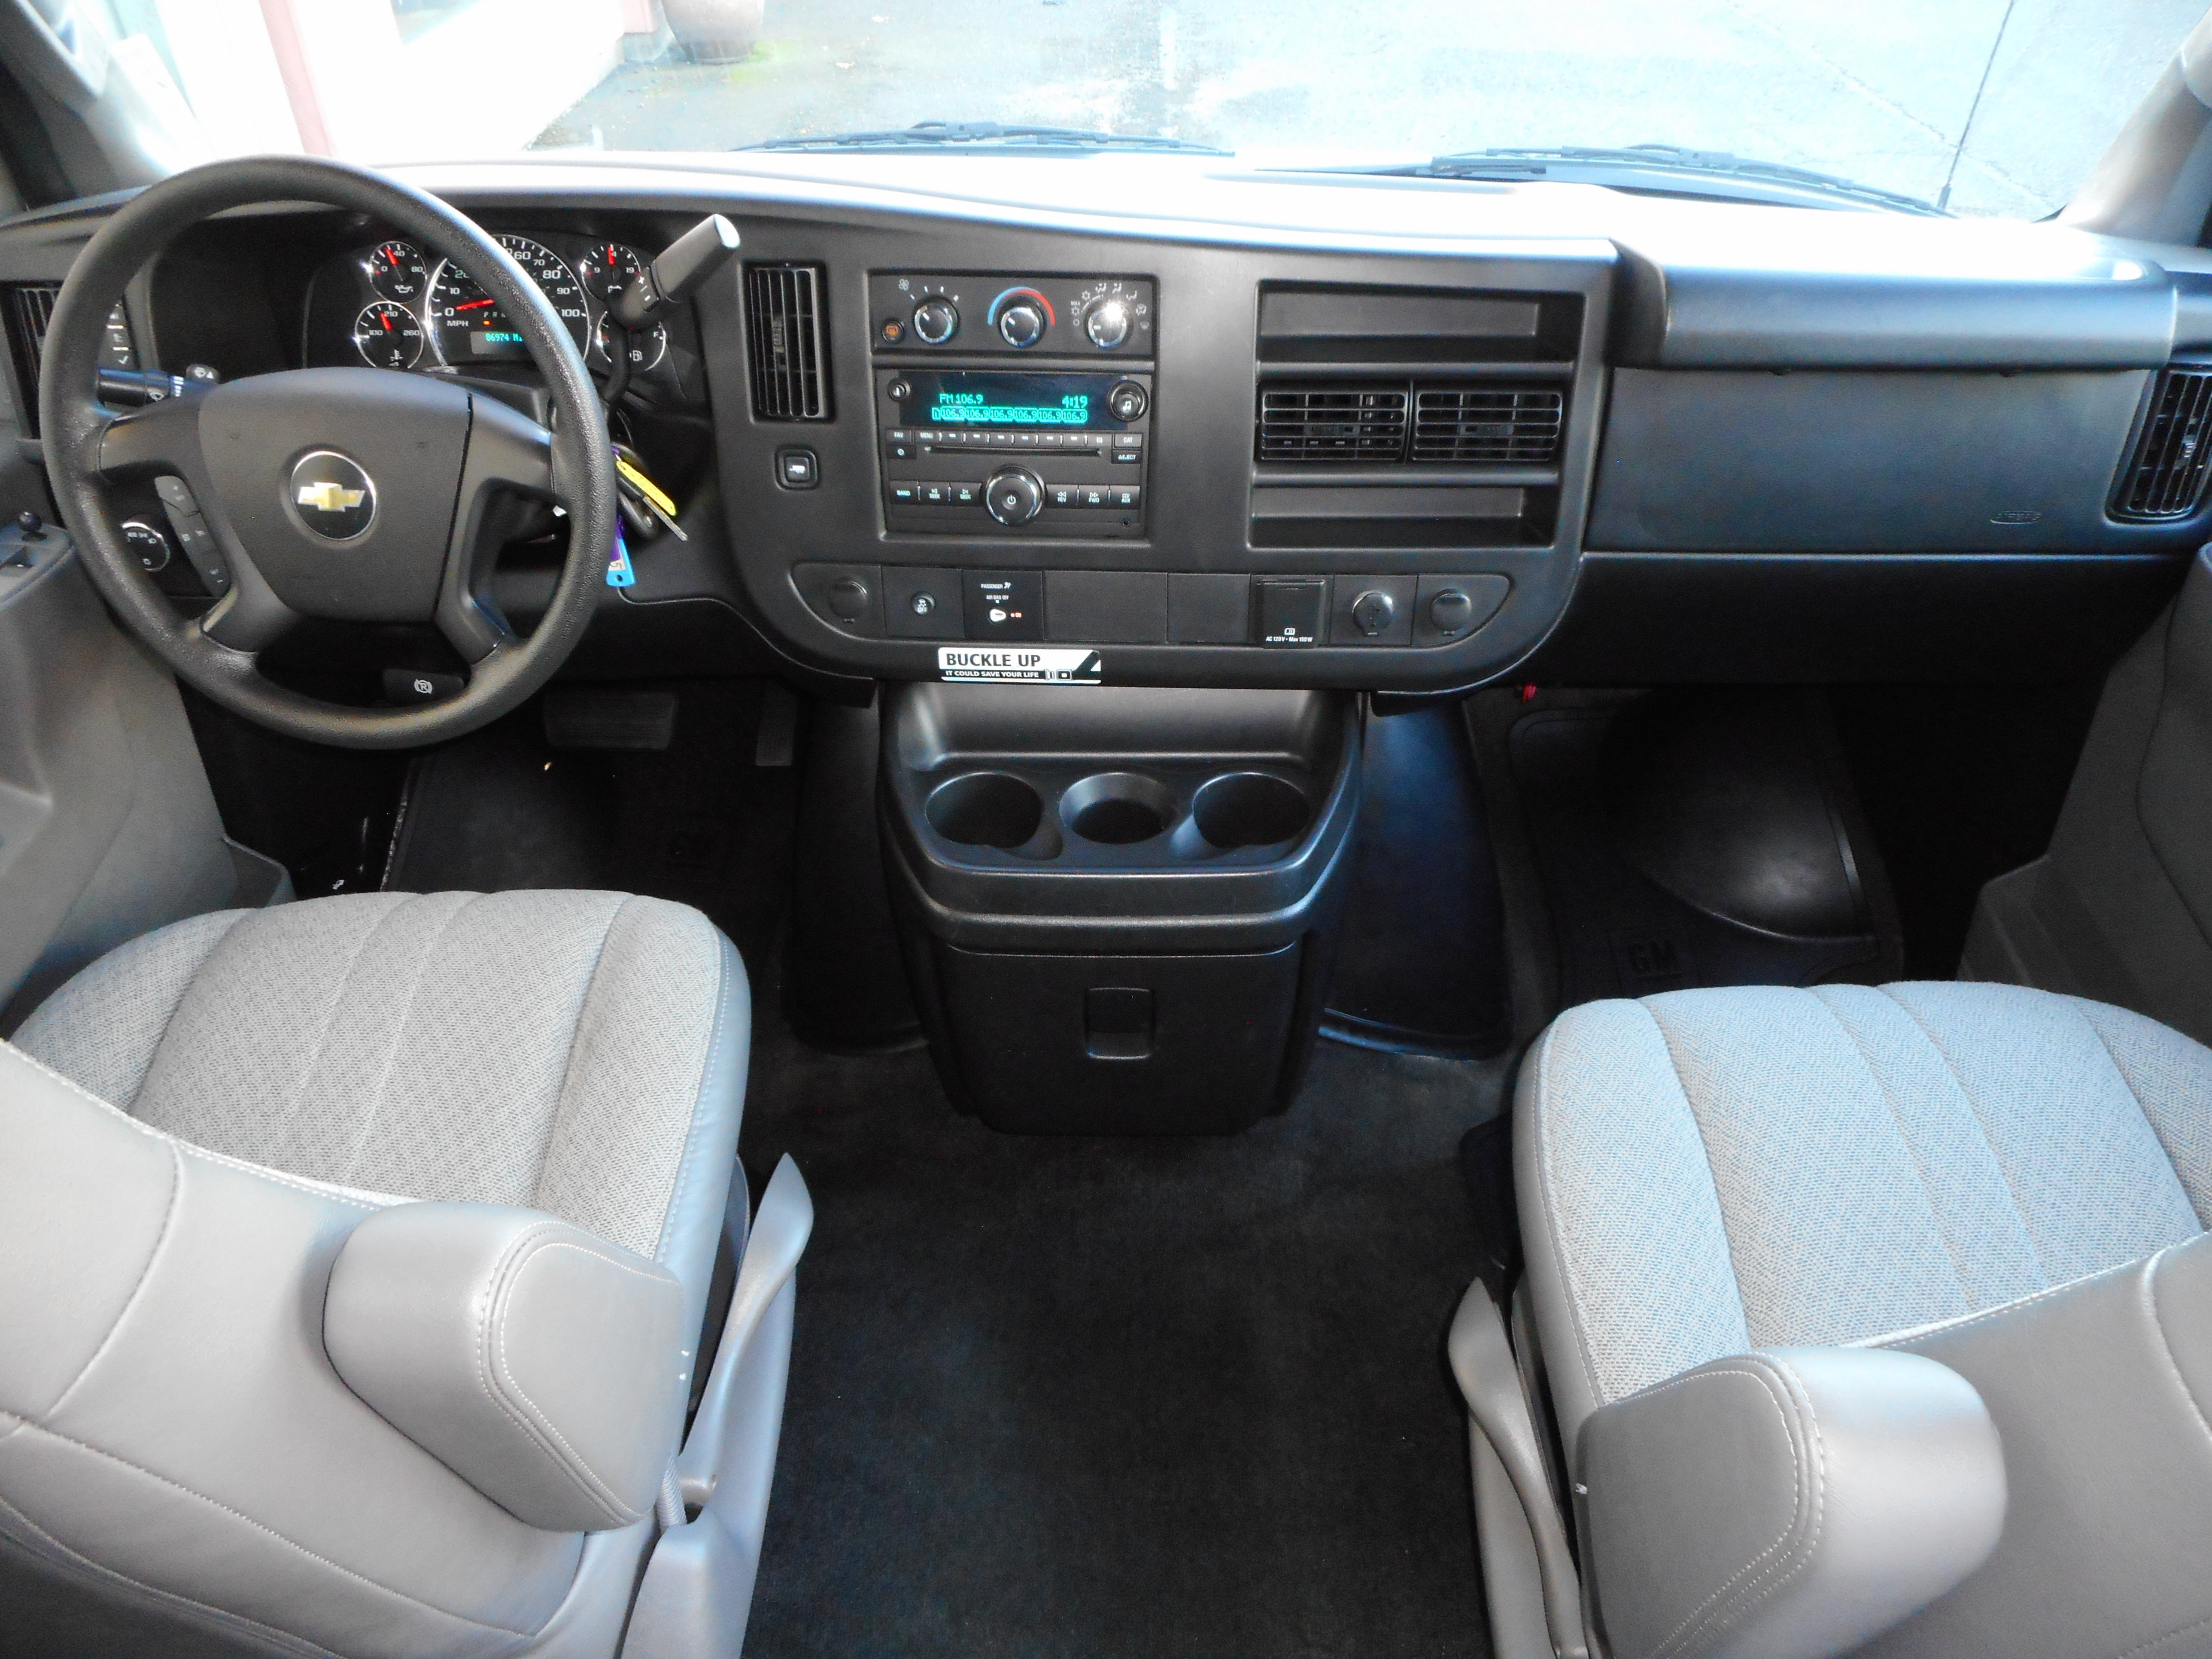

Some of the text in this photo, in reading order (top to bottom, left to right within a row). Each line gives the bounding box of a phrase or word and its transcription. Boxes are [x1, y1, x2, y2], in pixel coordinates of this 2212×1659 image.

[514, 251, 531, 260] 60
[542, 270, 561, 280] 80
[444, 307, 454, 316] 0
[561, 309, 580, 317] 100
[485, 333, 510, 342] 86974
[939, 394, 984, 404] FM 106.9
[1061, 395, 1088, 408] 4:19
[942, 408, 1086, 421] 106.9 106.9 106.9 106.9 106.9 106.9
[946, 653, 1041, 667] BUCKLE UP
